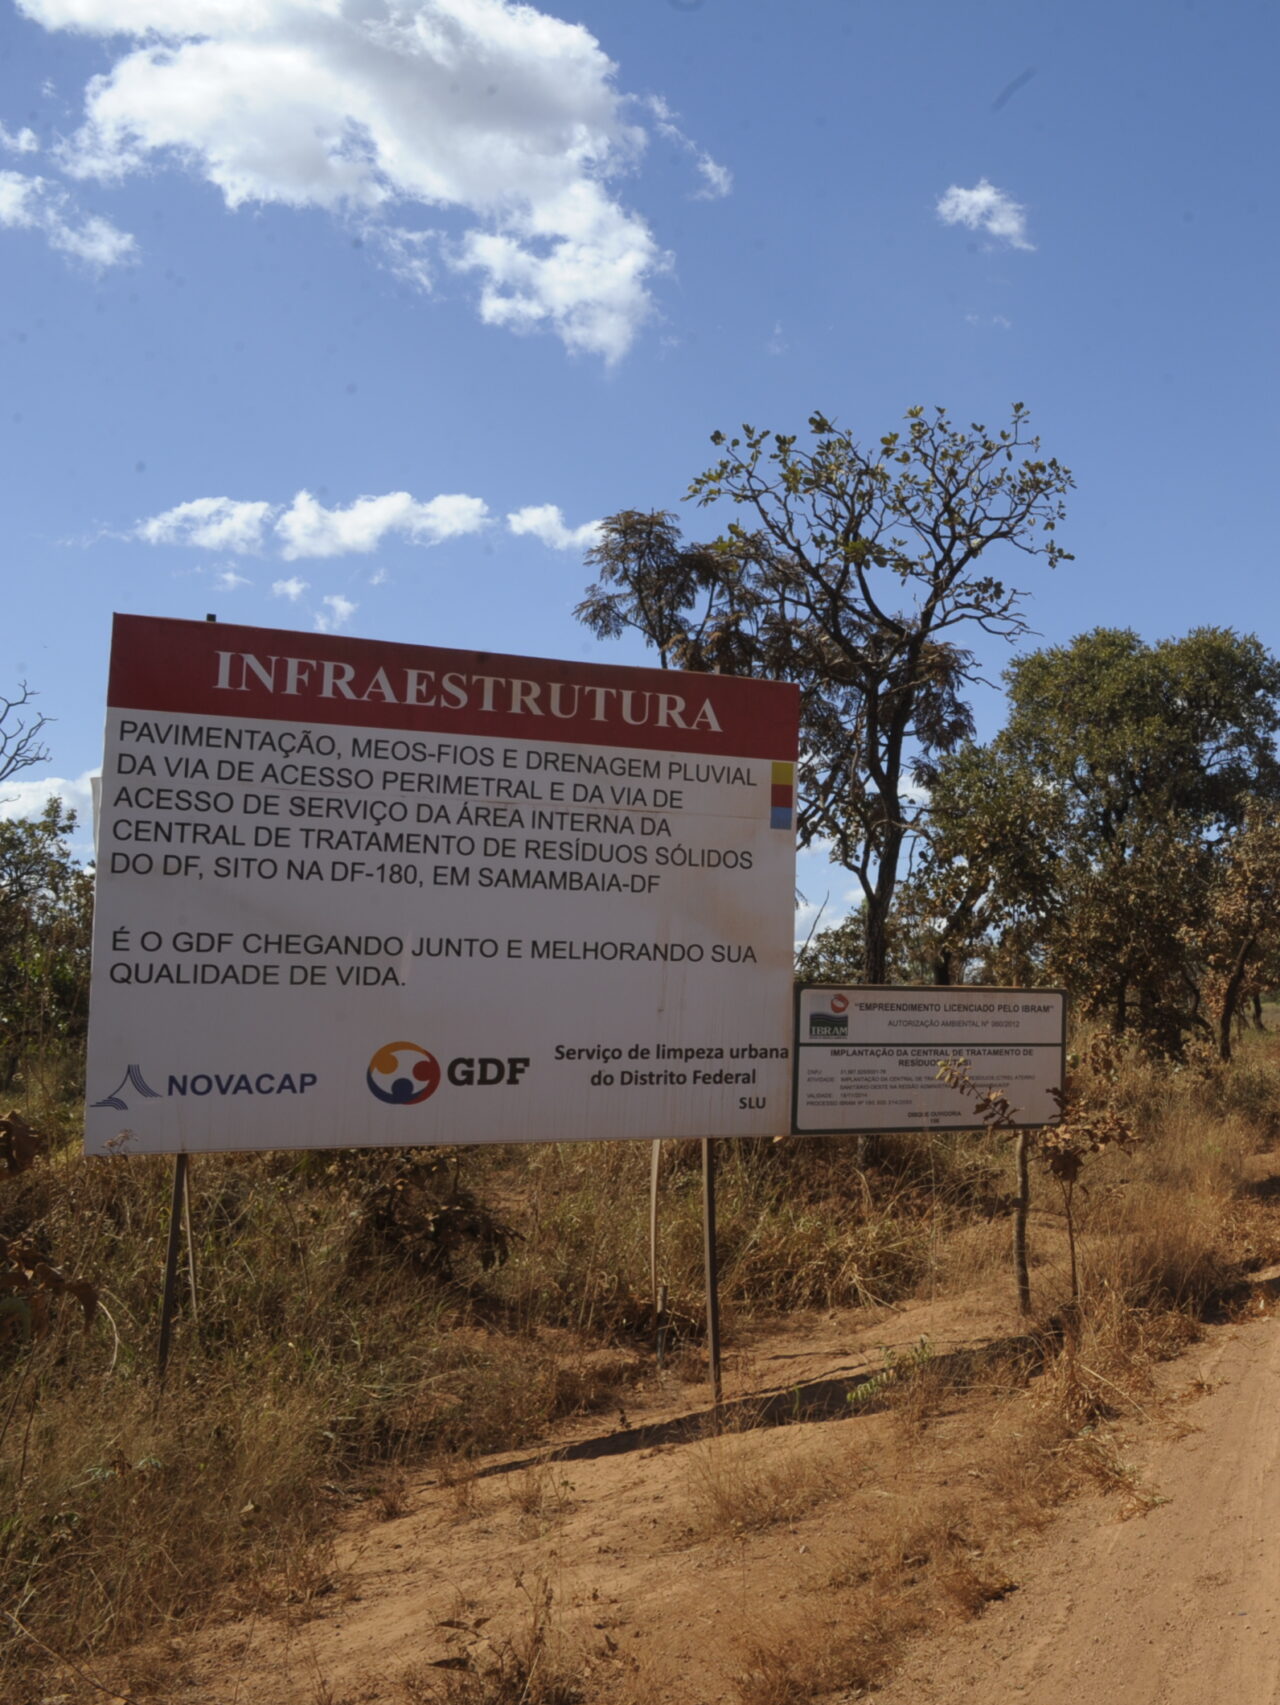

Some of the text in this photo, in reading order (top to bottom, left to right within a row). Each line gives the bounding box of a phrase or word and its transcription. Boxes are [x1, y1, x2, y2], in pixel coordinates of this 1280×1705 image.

[213, 651, 723, 732] INFRAESTRUTURA
[120, 720, 757, 786] PAVIMENTAÇÃO, MEOS-FIOS E DRENAGEM PLUVIAL
[117, 753, 683, 809] DA VIA DE ACESSO PERIMETRAL E DA VIA DE
[113, 786, 671, 837] ACESSO DE SERVIÇO DA ÁREA INTERNA DA
[113, 819, 752, 869] CENTRAL DE TRATAMENTO DE RESÍDUOS SÓLIDOS
[111, 852, 660, 893] DO DF, SITO NA DF-180, EM SAMAMBAIA-DF
[112, 926, 757, 963] É O GDF CHEGANDO JUNTO E MELHORANDO SUA
[110, 963, 405, 986] QUALIDADE DE VIDA.
[943, 1003, 995, 1013] LICENCIADO
[997, 1004, 1019, 1013] PELO
[811, 1026, 848, 1036] IBRAM
[887, 1019, 939, 1028] AUTORIZAÇÃO
[941, 1020, 979, 1028] AMBIENTAL
[554, 1044, 790, 1064] Serviço de limpeza urbana
[831, 1048, 894, 1058] IMPLANTAÇÃO
[447, 1057, 531, 1087] GDF
[590, 1068, 757, 1086] do Distrito Federal
[167, 1073, 318, 1097] NOVACAP
[738, 1096, 767, 1110] SLU
